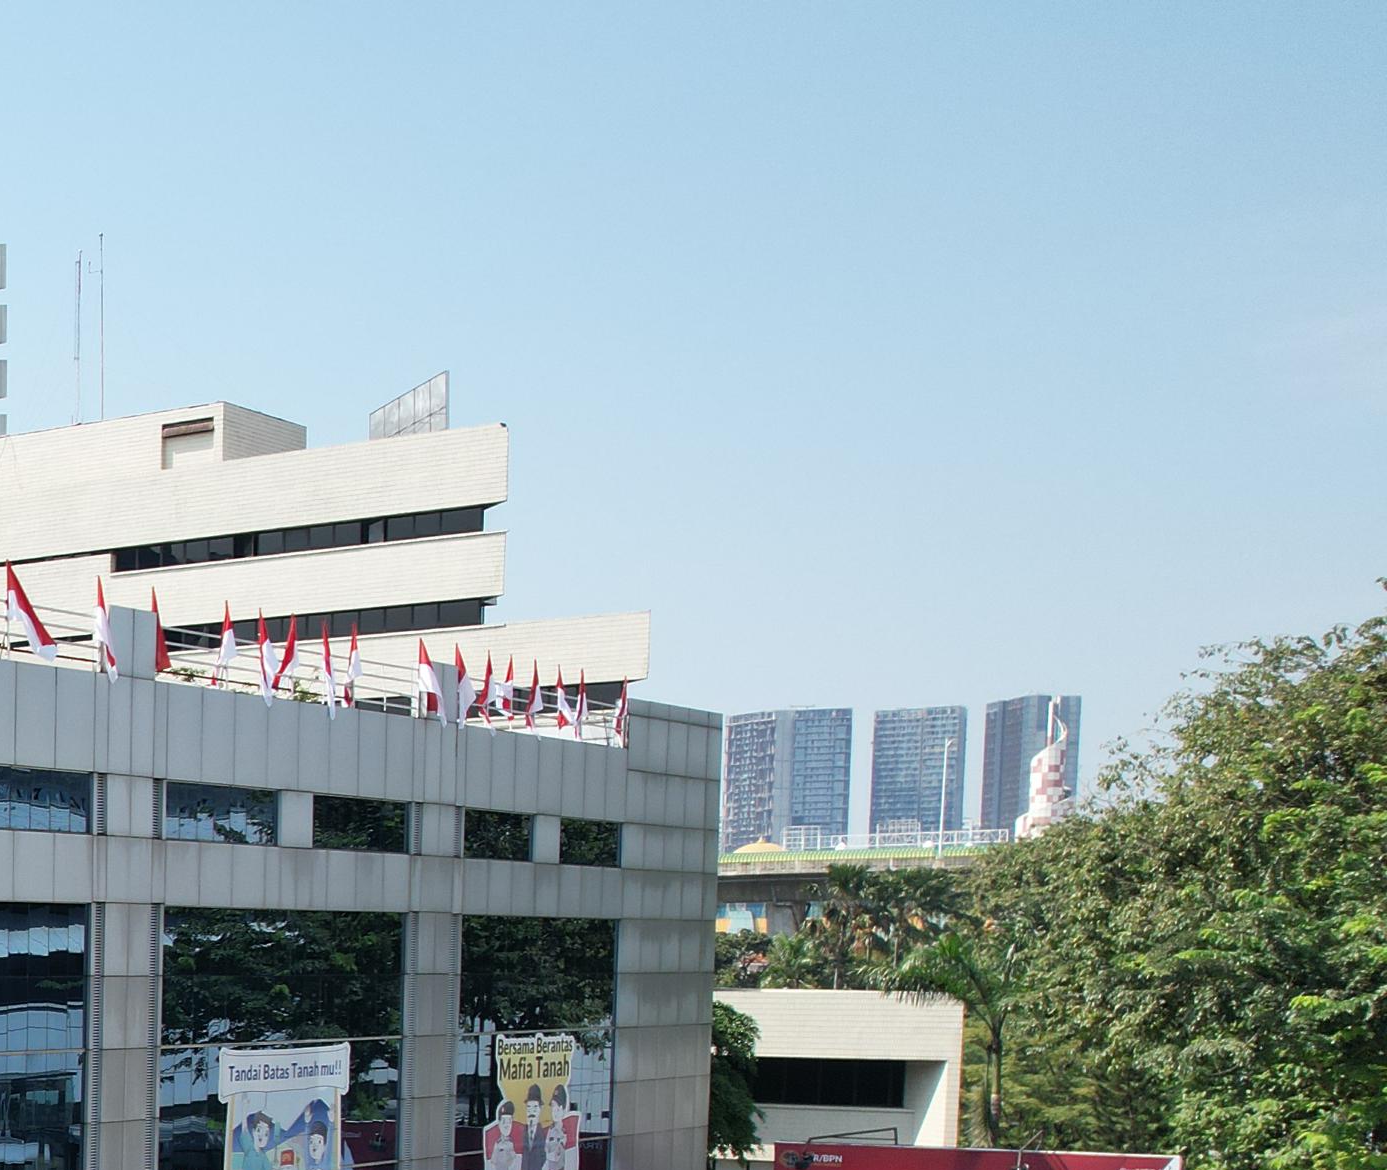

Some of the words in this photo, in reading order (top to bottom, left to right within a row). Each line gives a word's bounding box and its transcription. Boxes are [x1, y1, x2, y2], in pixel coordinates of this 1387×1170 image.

[497, 1040, 535, 1056] Bersama
[536, 1037, 573, 1054] Berantas
[228, 1065, 261, 1082] Tandai
[263, 1063, 290, 1080] Batas
[499, 1056, 533, 1081] Mafia
[536, 1054, 570, 1079] Tanah
